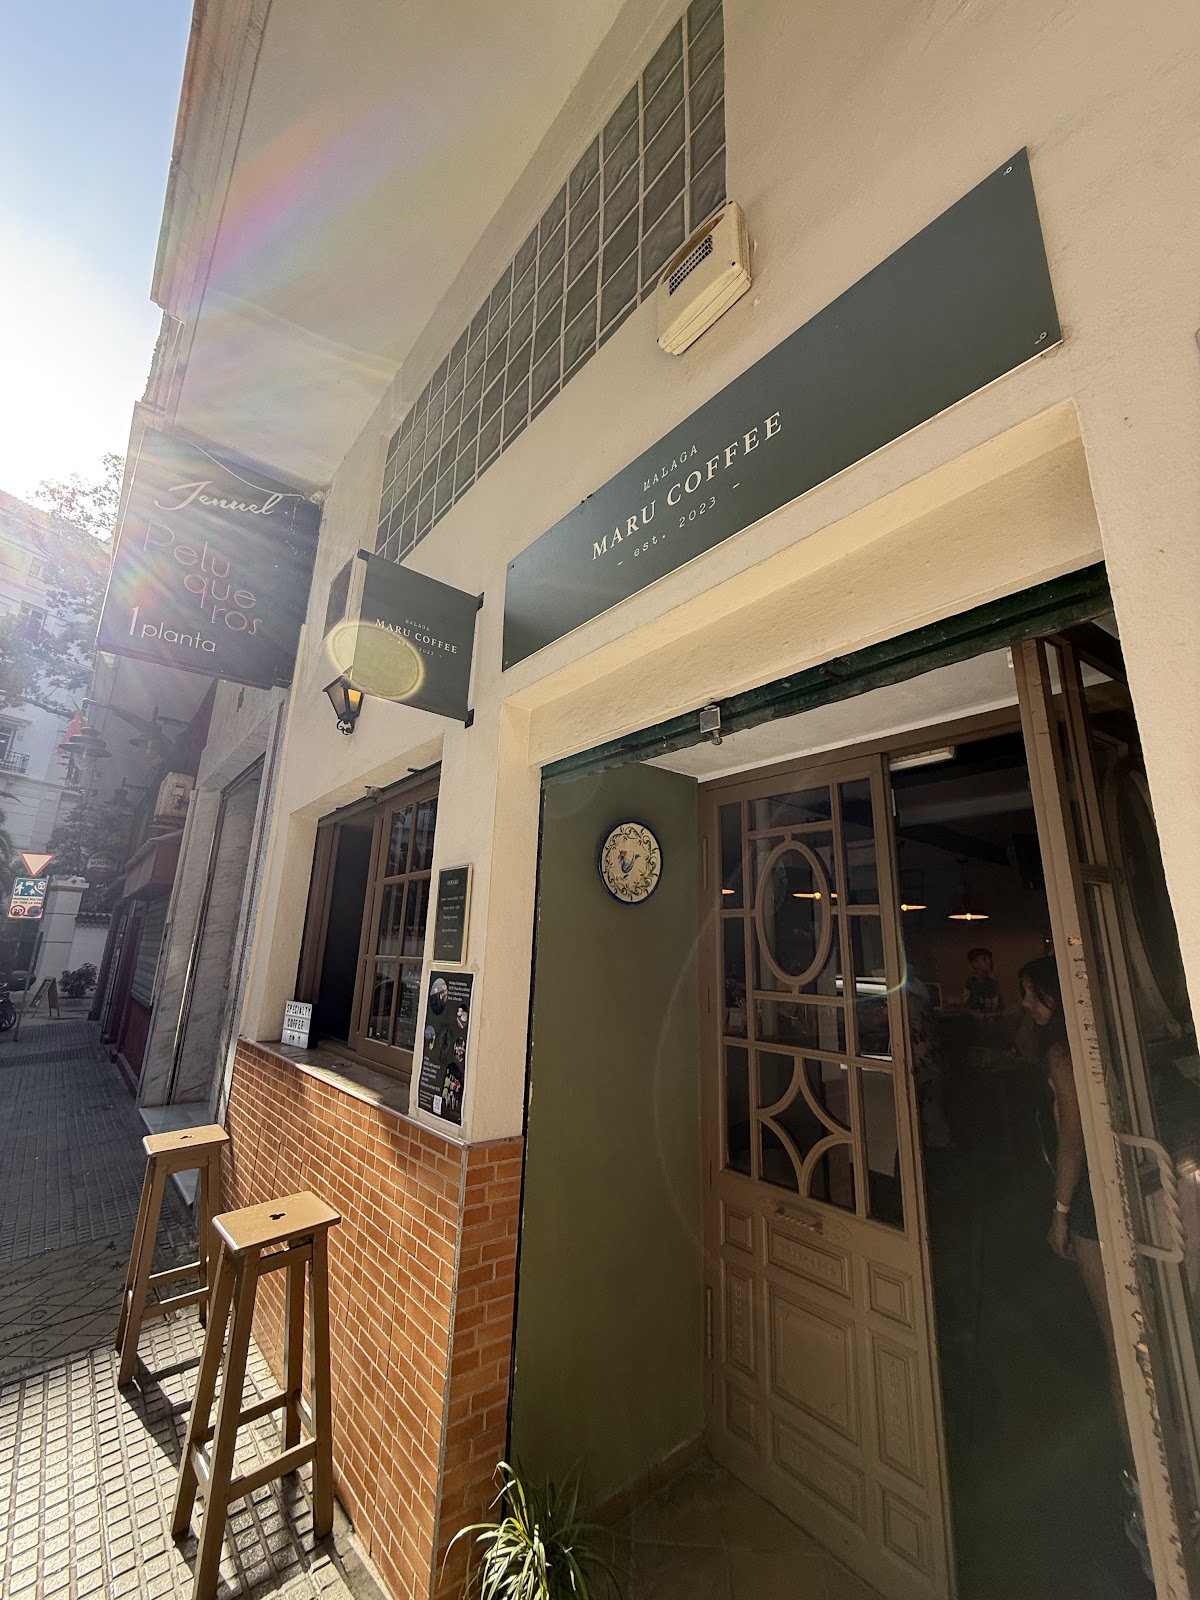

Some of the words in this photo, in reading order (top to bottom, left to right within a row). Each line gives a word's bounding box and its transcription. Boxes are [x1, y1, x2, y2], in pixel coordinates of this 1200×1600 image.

[591, 500, 656, 561] MARU
[666, 411, 782, 506] COFFEE
[642, 444, 698, 492] MALAGA
[143, 520, 231, 578] Pelu
[633, 534, 666, 557] est.
[678, 496, 716, 529] 2023
[184, 573, 257, 609] que
[129, 606, 140, 636] 1
[141, 622, 216, 653] planta
[211, 605, 263, 636] ros
[375, 618, 411, 637] MARU
[415, 632, 458, 654] COFFEE
[286, 1003, 311, 1017] SPECIALTY
